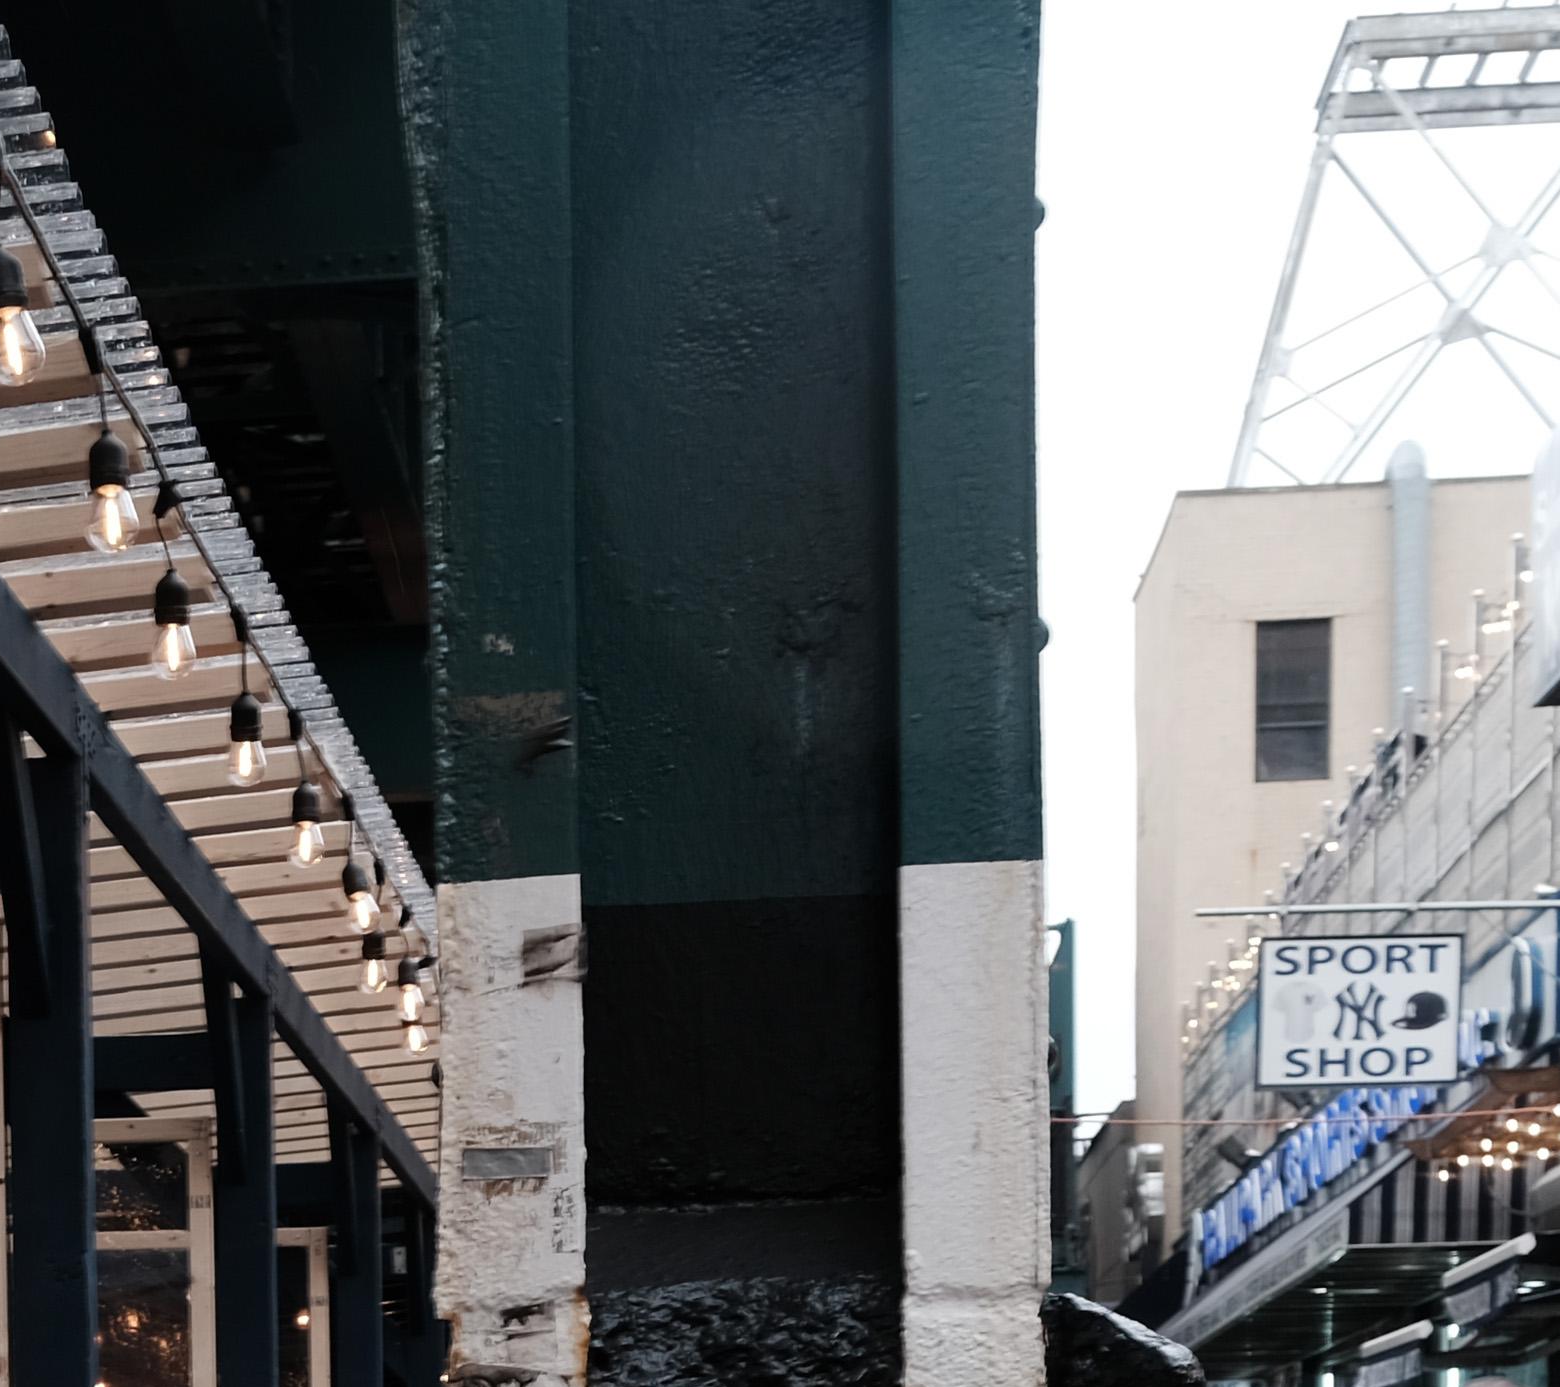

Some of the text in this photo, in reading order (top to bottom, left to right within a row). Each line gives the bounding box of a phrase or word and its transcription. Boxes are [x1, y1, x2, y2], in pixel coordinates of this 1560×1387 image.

[1275, 944, 1448, 975] SPORT
[1333, 981, 1386, 1040] NY
[1285, 1047, 1433, 1078] SHOP
